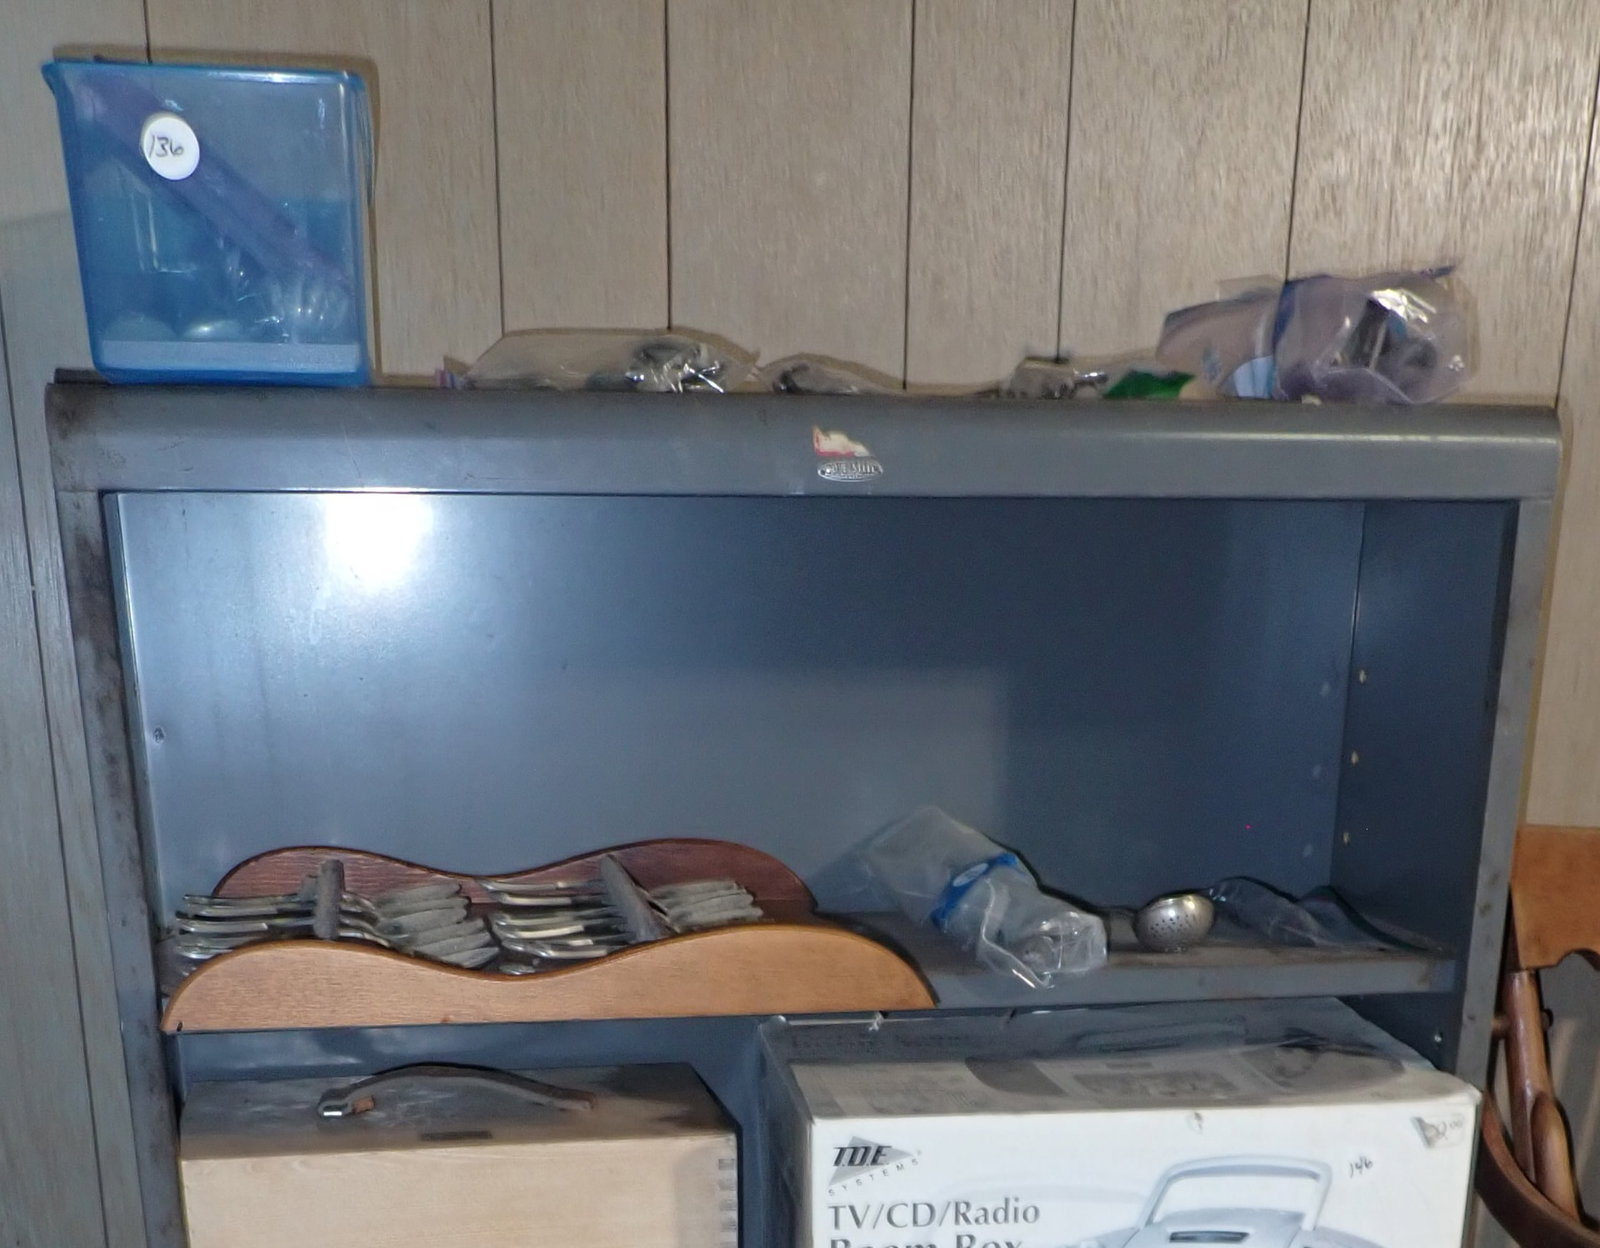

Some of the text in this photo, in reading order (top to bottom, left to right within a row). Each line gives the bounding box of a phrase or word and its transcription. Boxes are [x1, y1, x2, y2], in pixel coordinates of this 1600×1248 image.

[149, 134, 184, 158] 136
[828, 1158, 919, 1197] SYSTEMS
[828, 1197, 1040, 1230] TV/CD/Radio
